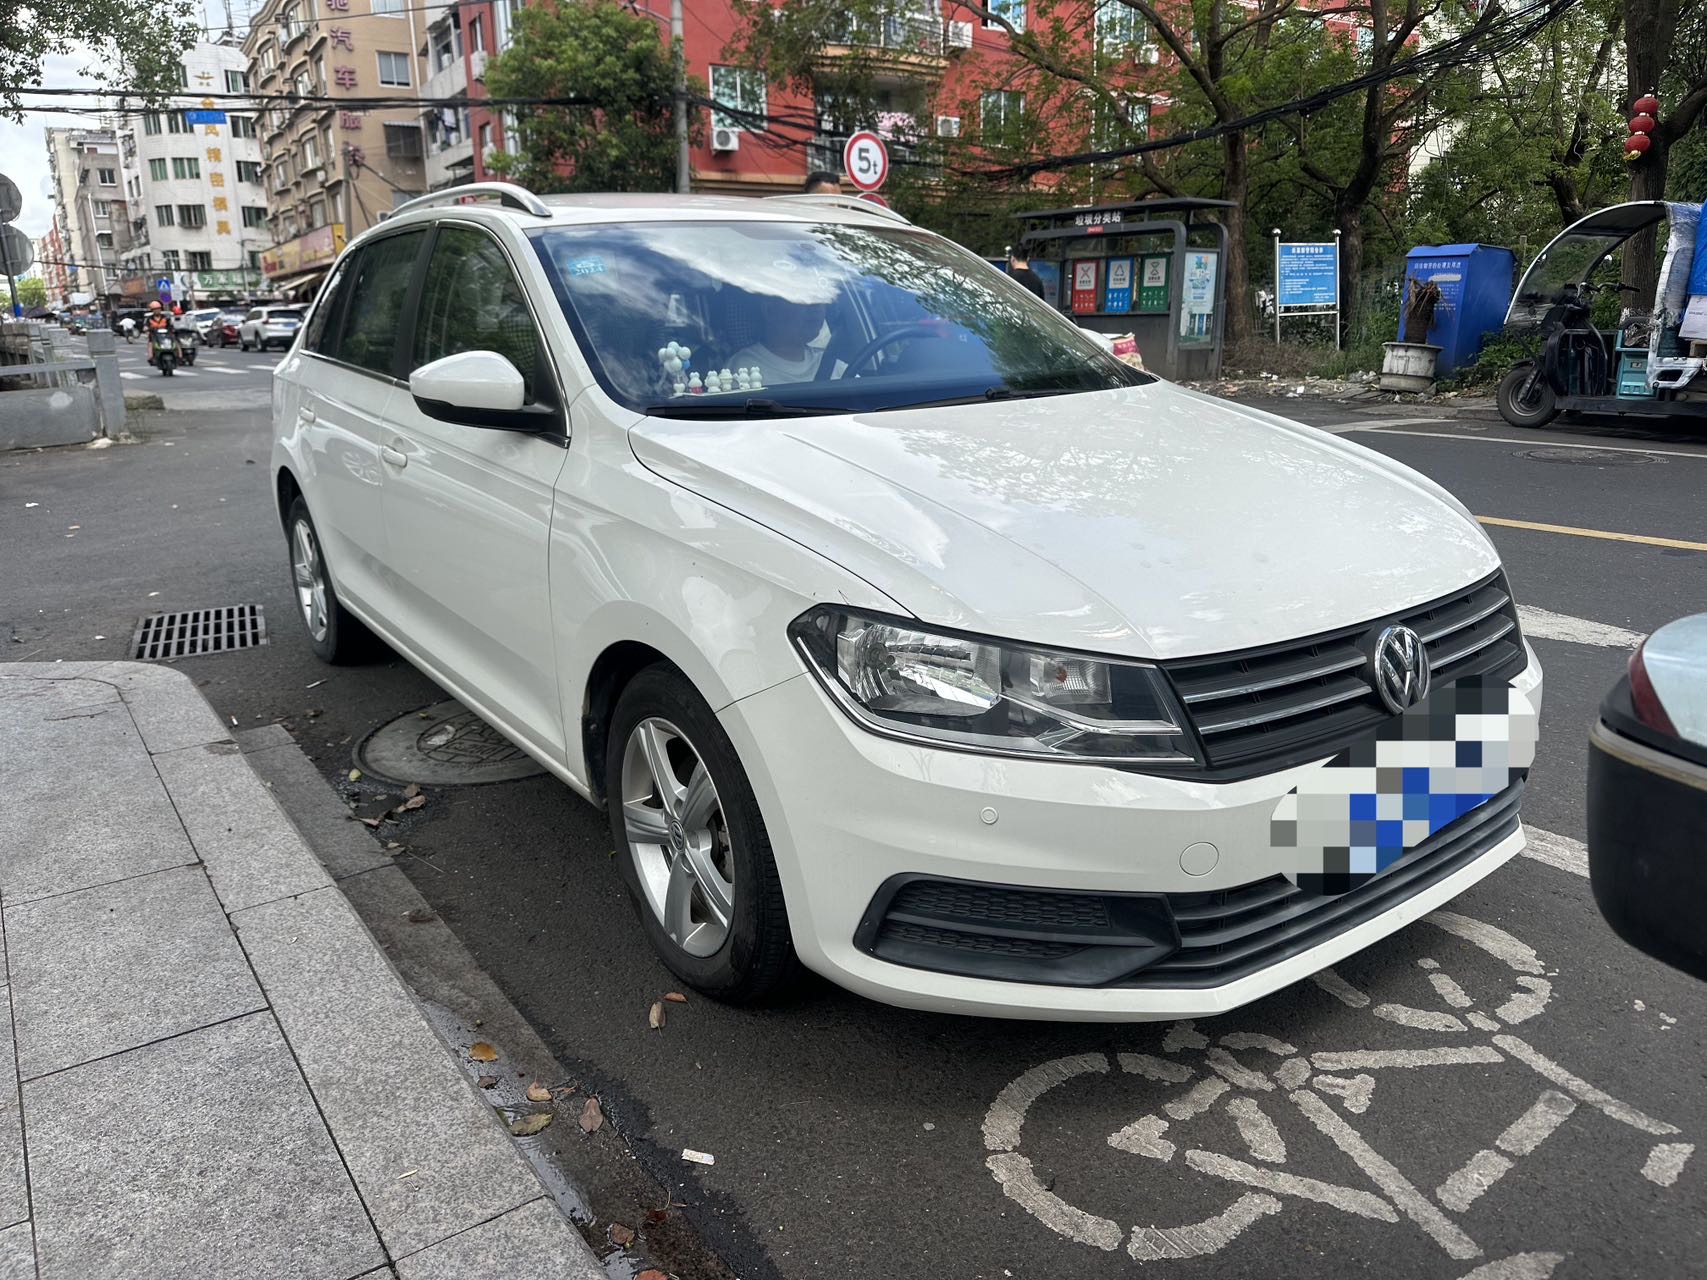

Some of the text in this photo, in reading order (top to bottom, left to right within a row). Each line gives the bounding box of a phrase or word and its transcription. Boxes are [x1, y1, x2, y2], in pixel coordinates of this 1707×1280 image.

[857, 147, 878, 175] 5t
[1075, 211, 1121, 225] 垃圾分类站
